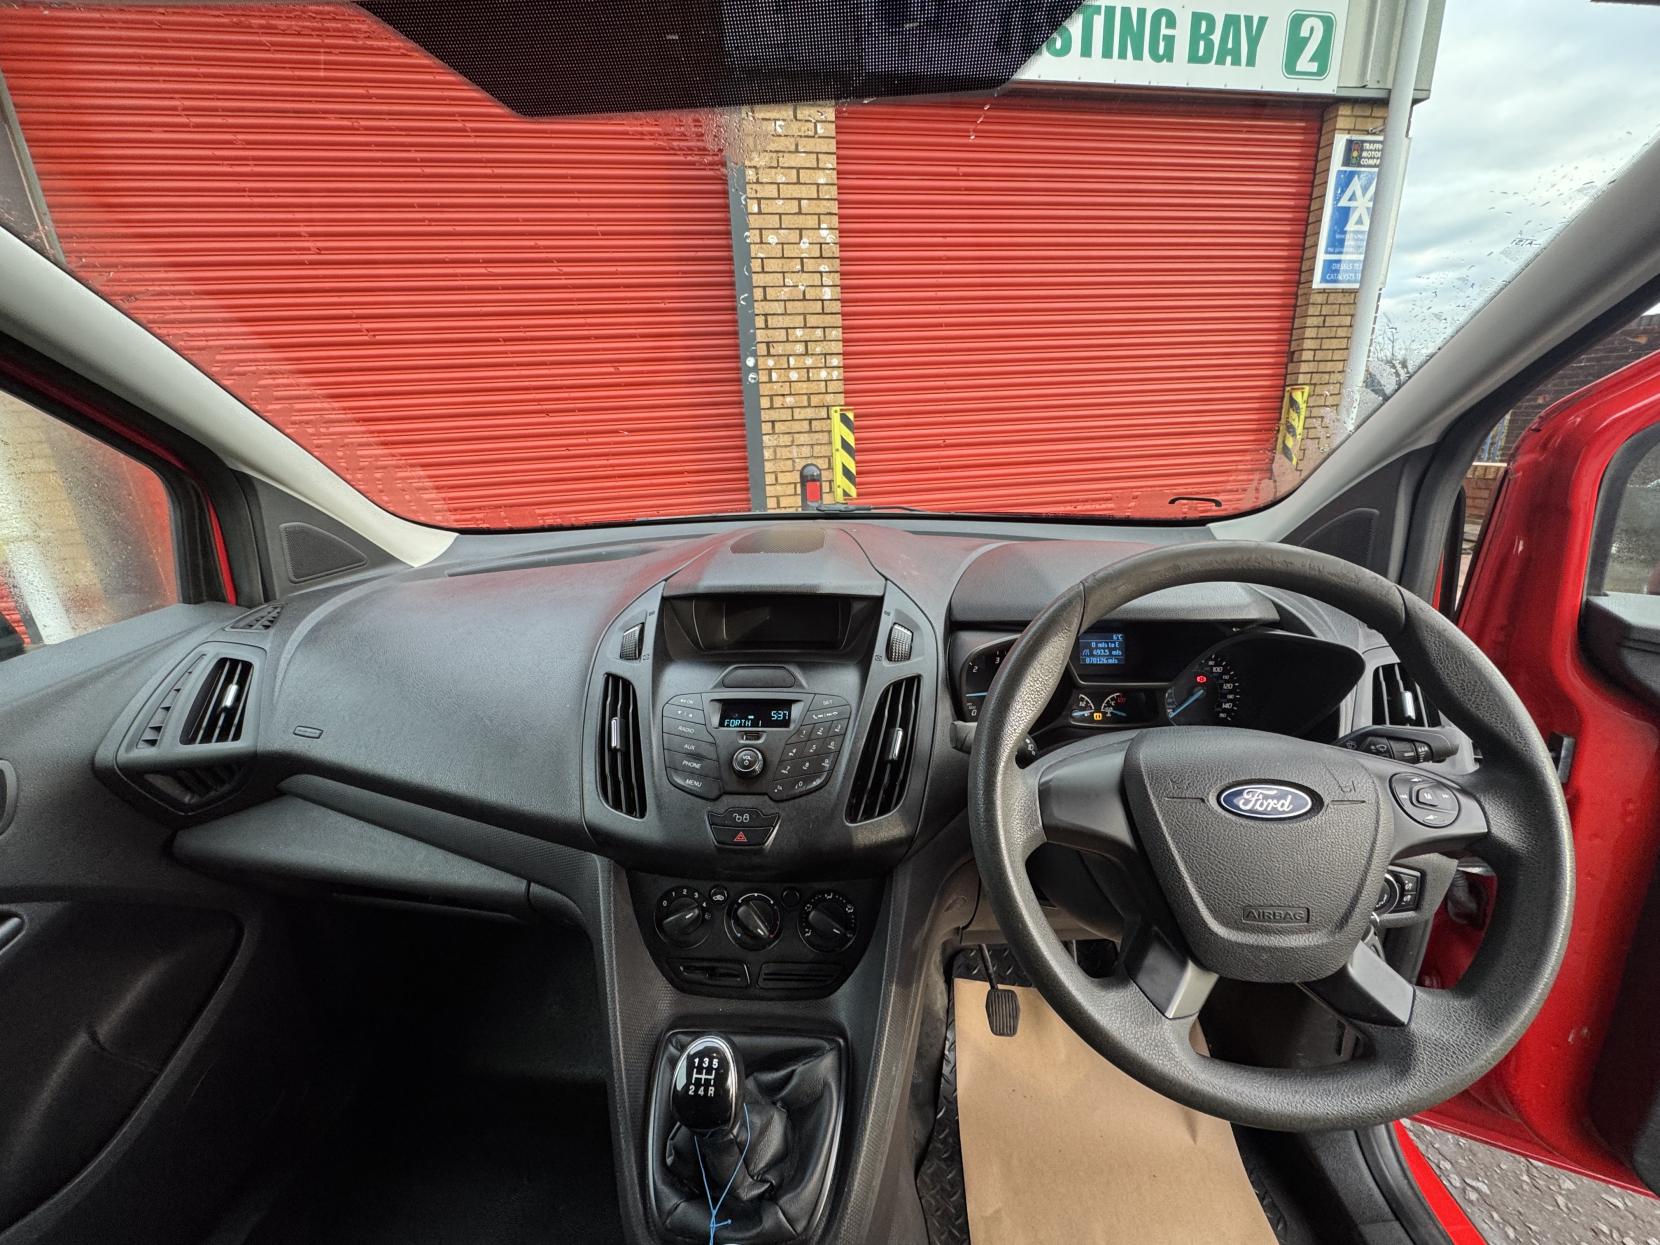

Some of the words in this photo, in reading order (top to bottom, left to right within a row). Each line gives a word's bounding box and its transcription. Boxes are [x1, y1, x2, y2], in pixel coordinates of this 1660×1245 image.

[1044, 4, 1177, 63] STING
[1187, 11, 1269, 68] BAY
[1295, 17, 1325, 73] 2
[724, 719, 752, 728] FORTH
[678, 725, 695, 734] RADIO
[683, 743, 696, 751] AUX
[682, 760, 702, 769] PHONE
[685, 778, 703, 787] MENU
[1238, 788, 1293, 812] Ford
[1244, 911, 1305, 921] AIRBAG
[702, 1057, 709, 1068] 3
[711, 1058, 719, 1069] 5
[688, 1085, 695, 1095] 2
[697, 1086, 704, 1096] 4
[707, 1086, 715, 1097] R
